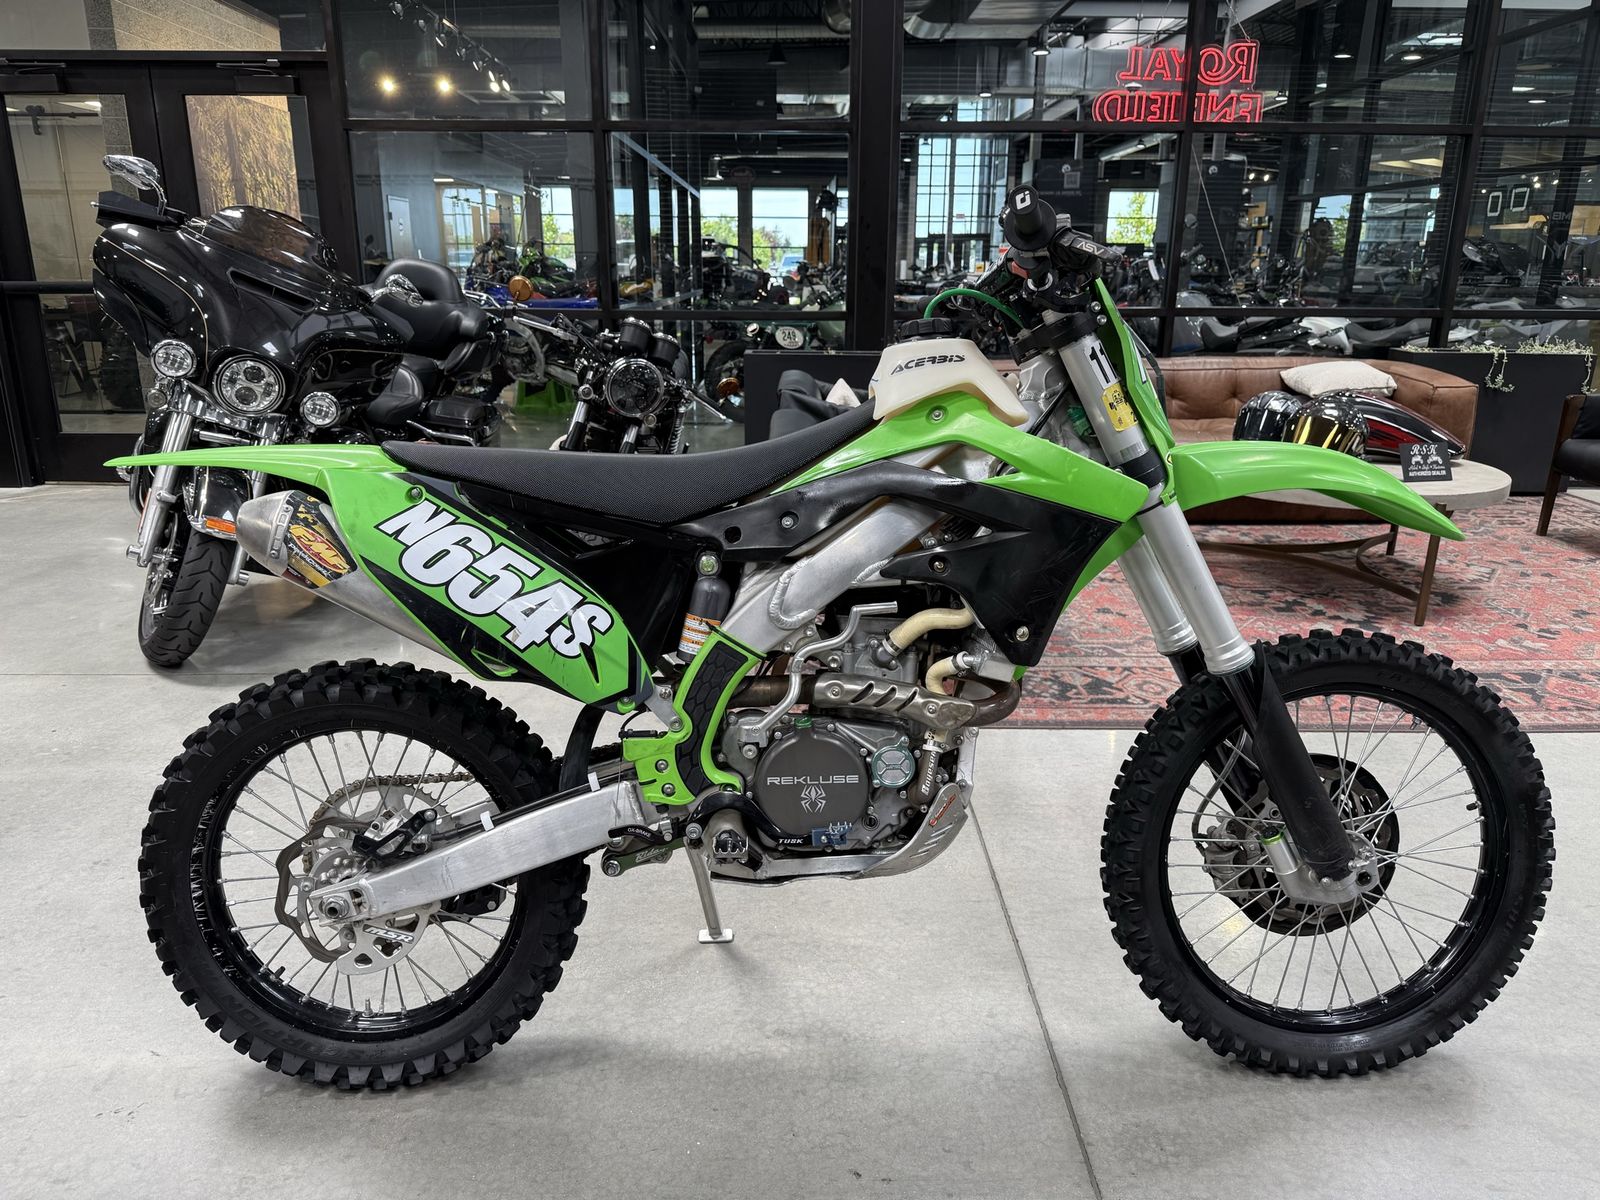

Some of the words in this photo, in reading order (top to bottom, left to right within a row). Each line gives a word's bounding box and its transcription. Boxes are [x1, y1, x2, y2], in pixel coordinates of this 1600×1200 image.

[1077, 241, 1105, 255] ASV
[890, 354, 965, 376] ACERBIS
[289, 526, 350, 573] FMF
[767, 774, 859, 786] REKLUSE
